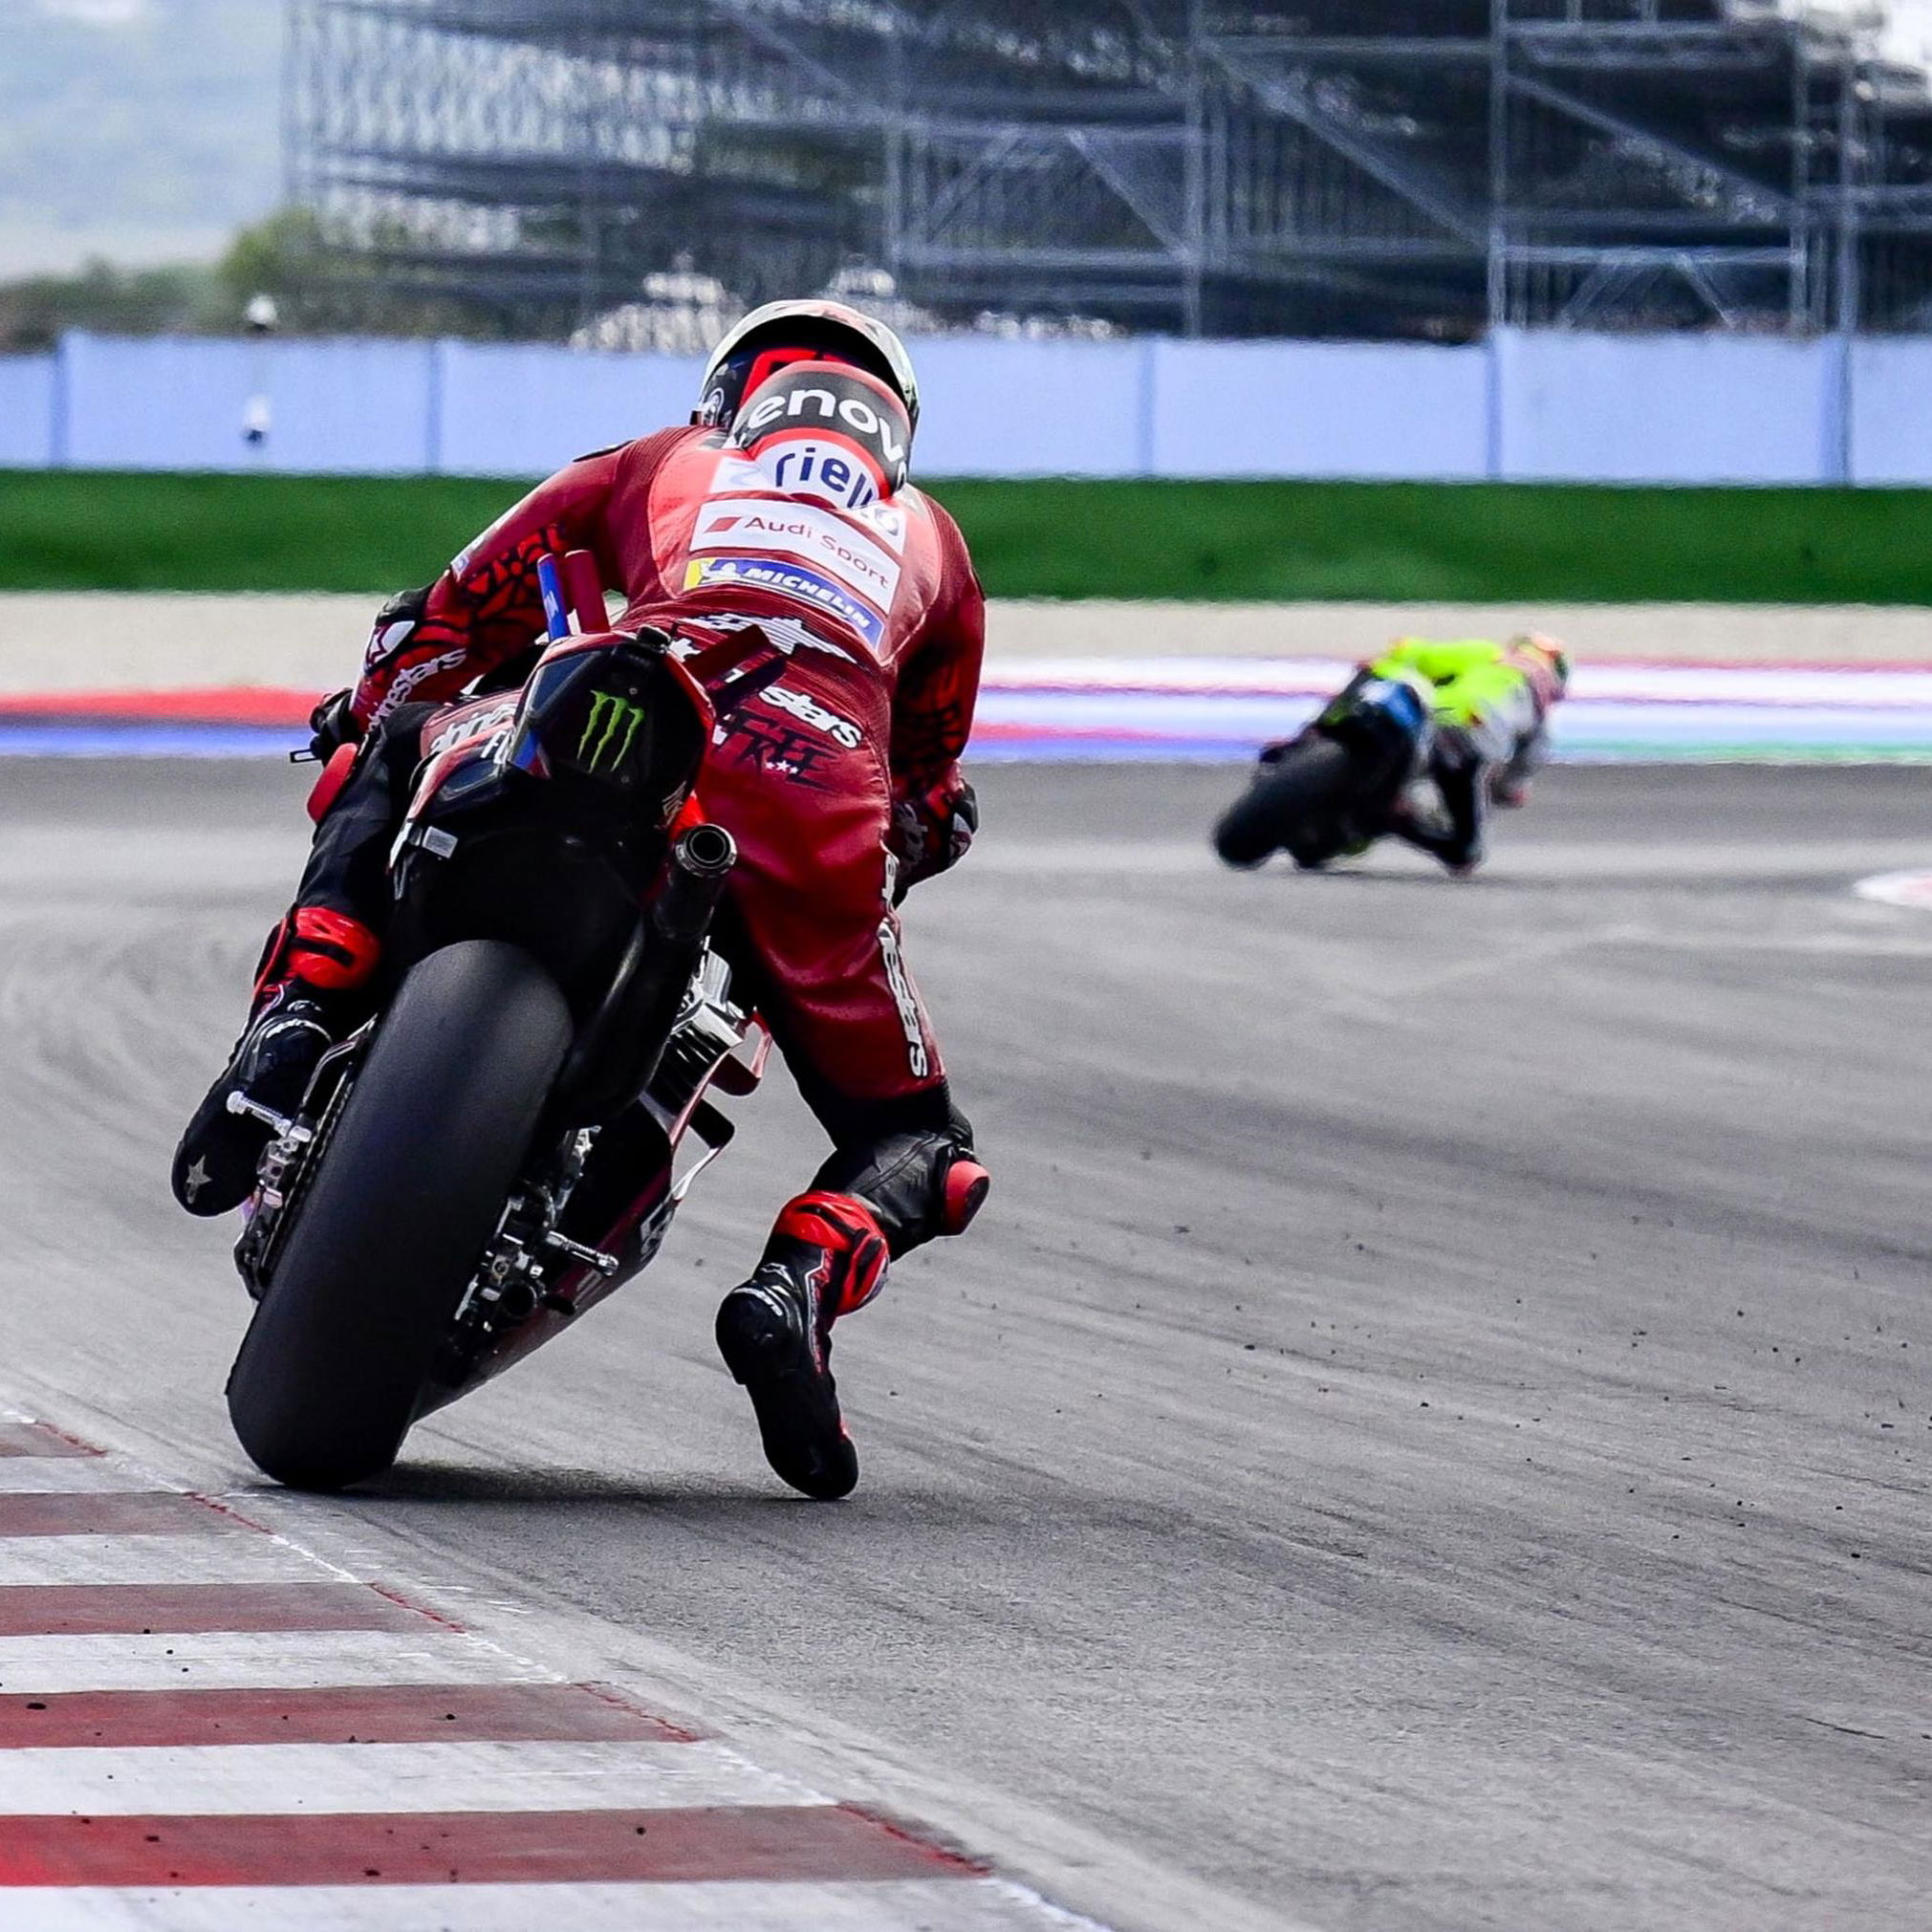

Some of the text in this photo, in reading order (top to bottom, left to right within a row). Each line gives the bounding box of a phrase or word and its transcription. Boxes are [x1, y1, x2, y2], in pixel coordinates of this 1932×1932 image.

[744, 516, 889, 589] Audi Sport
[744, 567, 872, 628] MICHELIN
